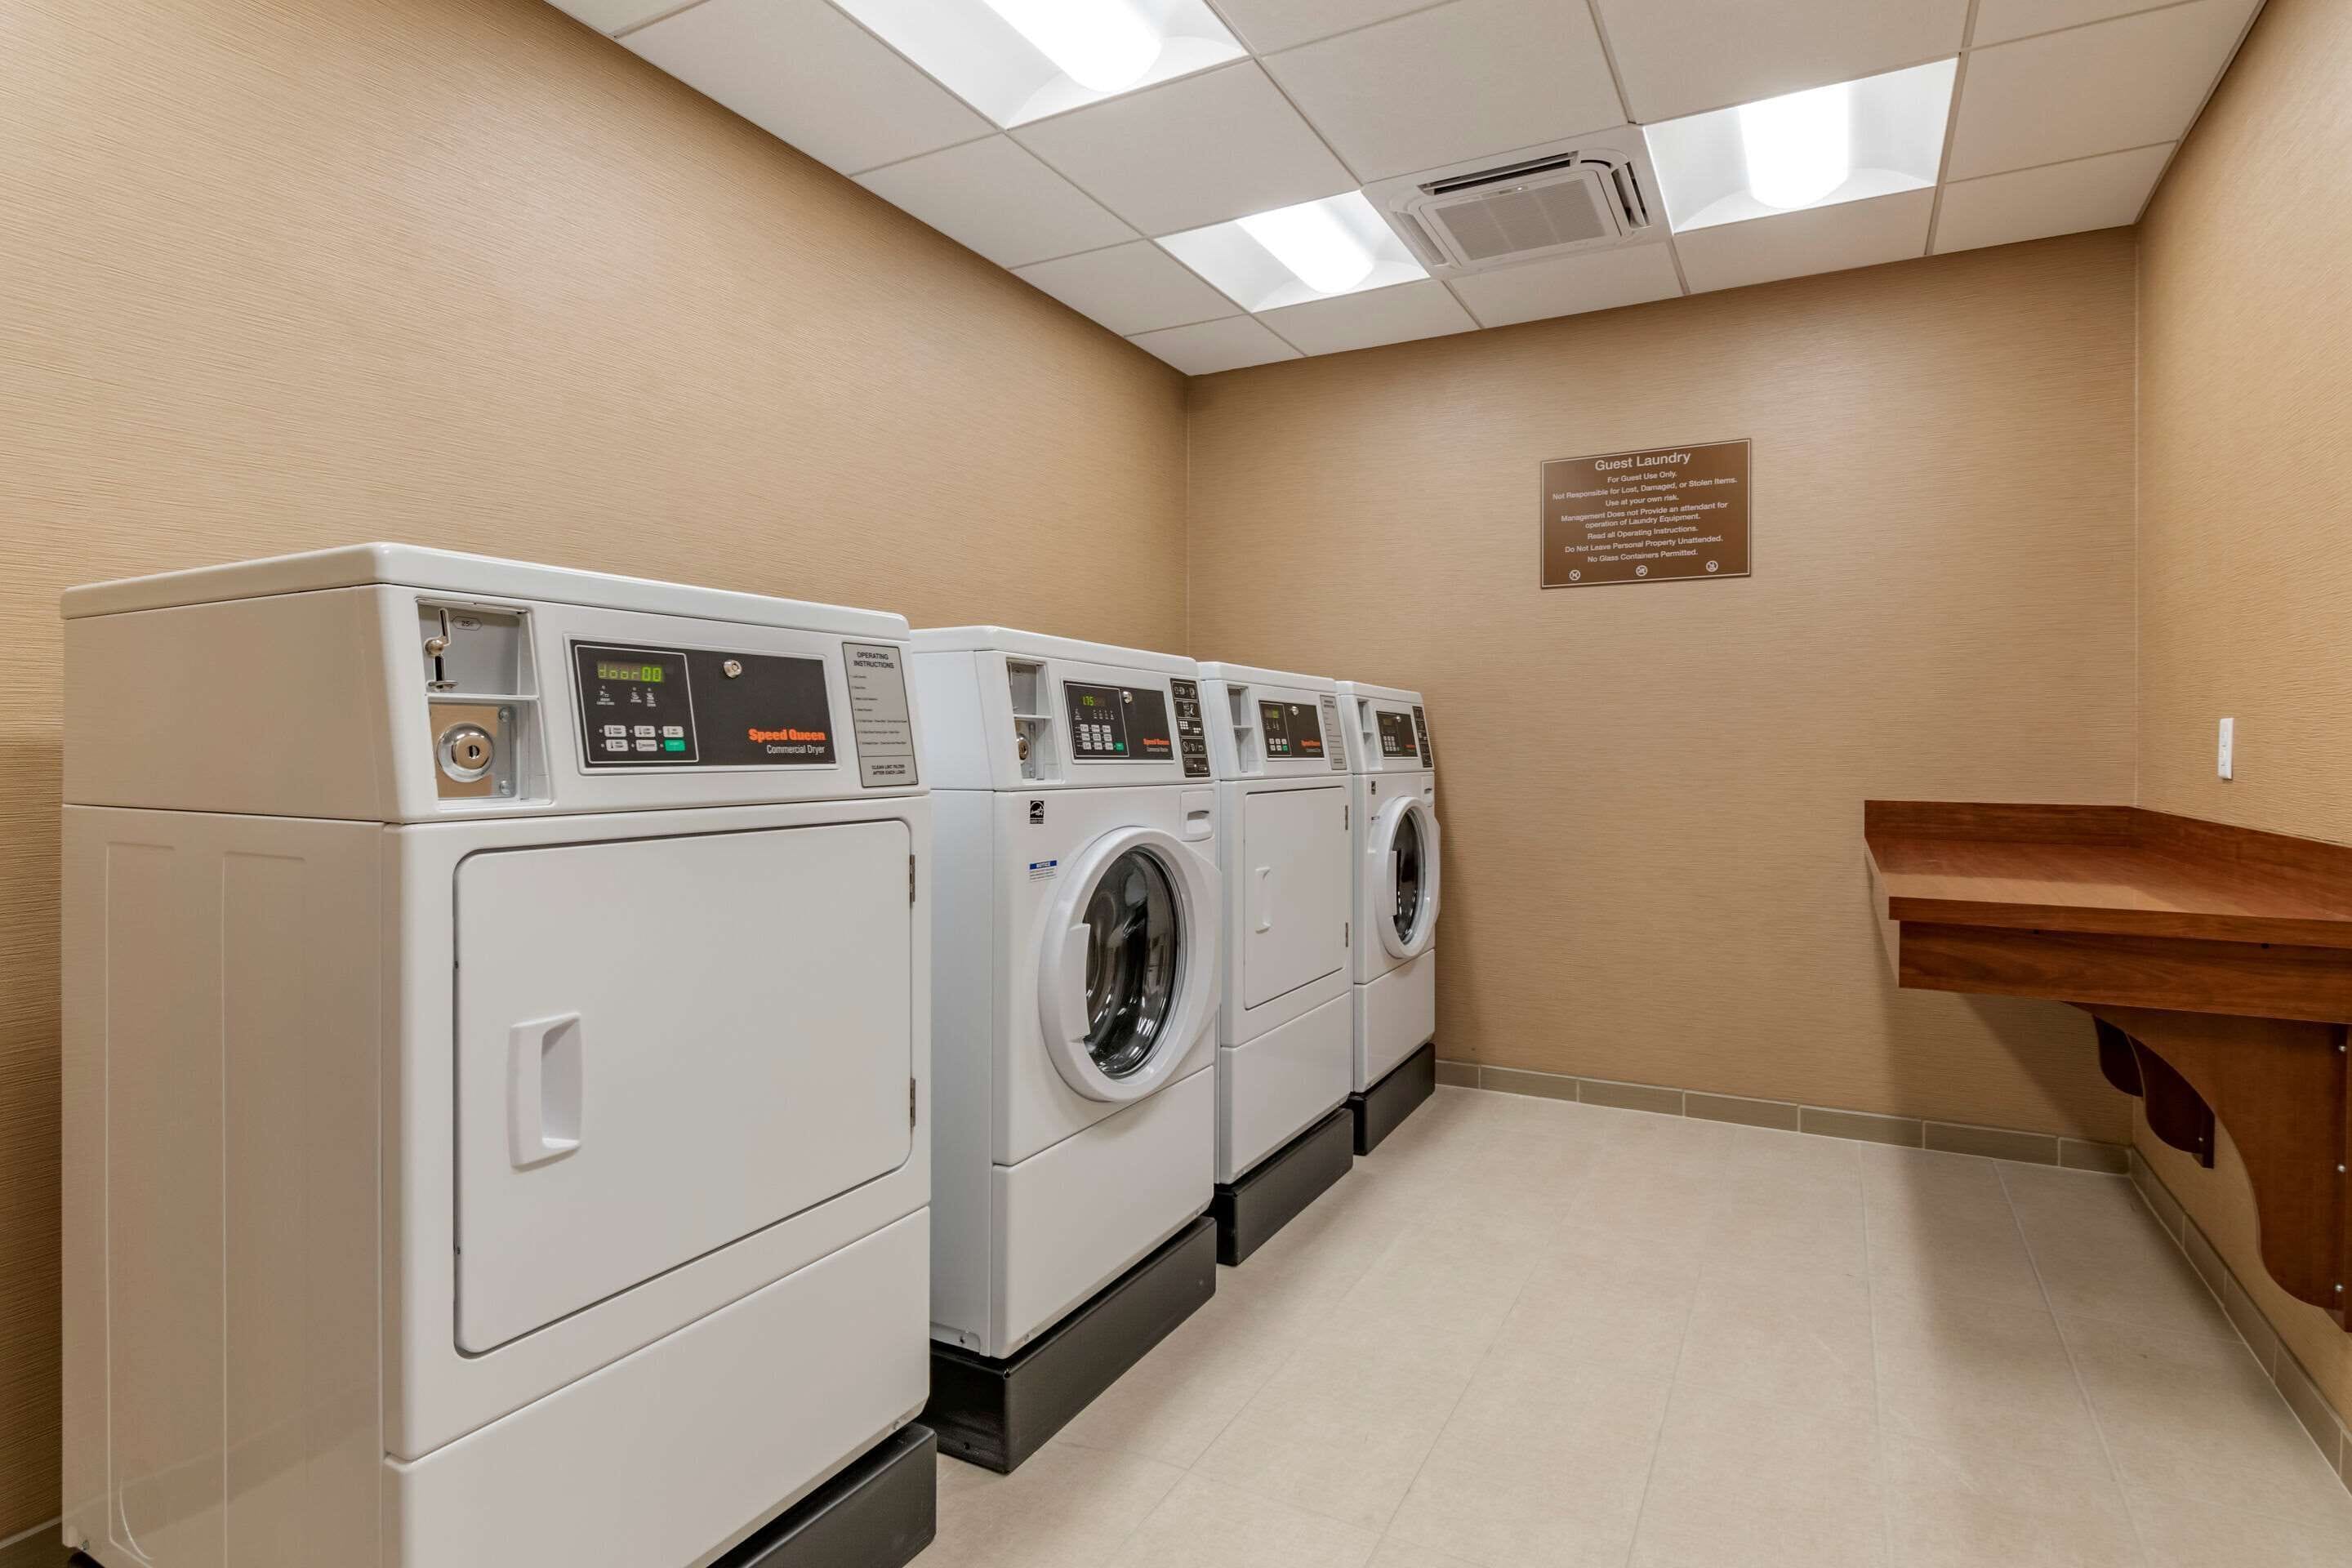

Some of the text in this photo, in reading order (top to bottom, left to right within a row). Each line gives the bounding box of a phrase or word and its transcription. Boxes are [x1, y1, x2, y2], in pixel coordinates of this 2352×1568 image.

[1595, 452, 1690, 470] Guest Laundry
[1621, 474, 1642, 482] Guest
[1566, 489, 1608, 498] Responsible
[1641, 483, 1677, 491] Damaged,
[1689, 479, 1713, 487] Stolen
[1561, 513, 1606, 522] Management
[1680, 502, 1716, 511] attendant
[1585, 520, 1618, 529] operation
[1628, 516, 1658, 525] Laundry
[1659, 514, 1700, 523] Equipment.
[1617, 528, 1652, 537] Operating
[1654, 525, 1699, 534] Instructions.
[1613, 541, 1643, 549] Personal
[1646, 539, 1676, 547] Property
[1677, 535, 1723, 545] Unattended.
[1620, 552, 1659, 560] Containers
[1660, 549, 1698, 557] Permitted.
[857, 652, 889, 660] OPERATING
[853, 661, 894, 669] INSTRUCTIONS
[748, 728, 826, 743] Speed Queen
[767, 744, 825, 755] Commercial Dryer
